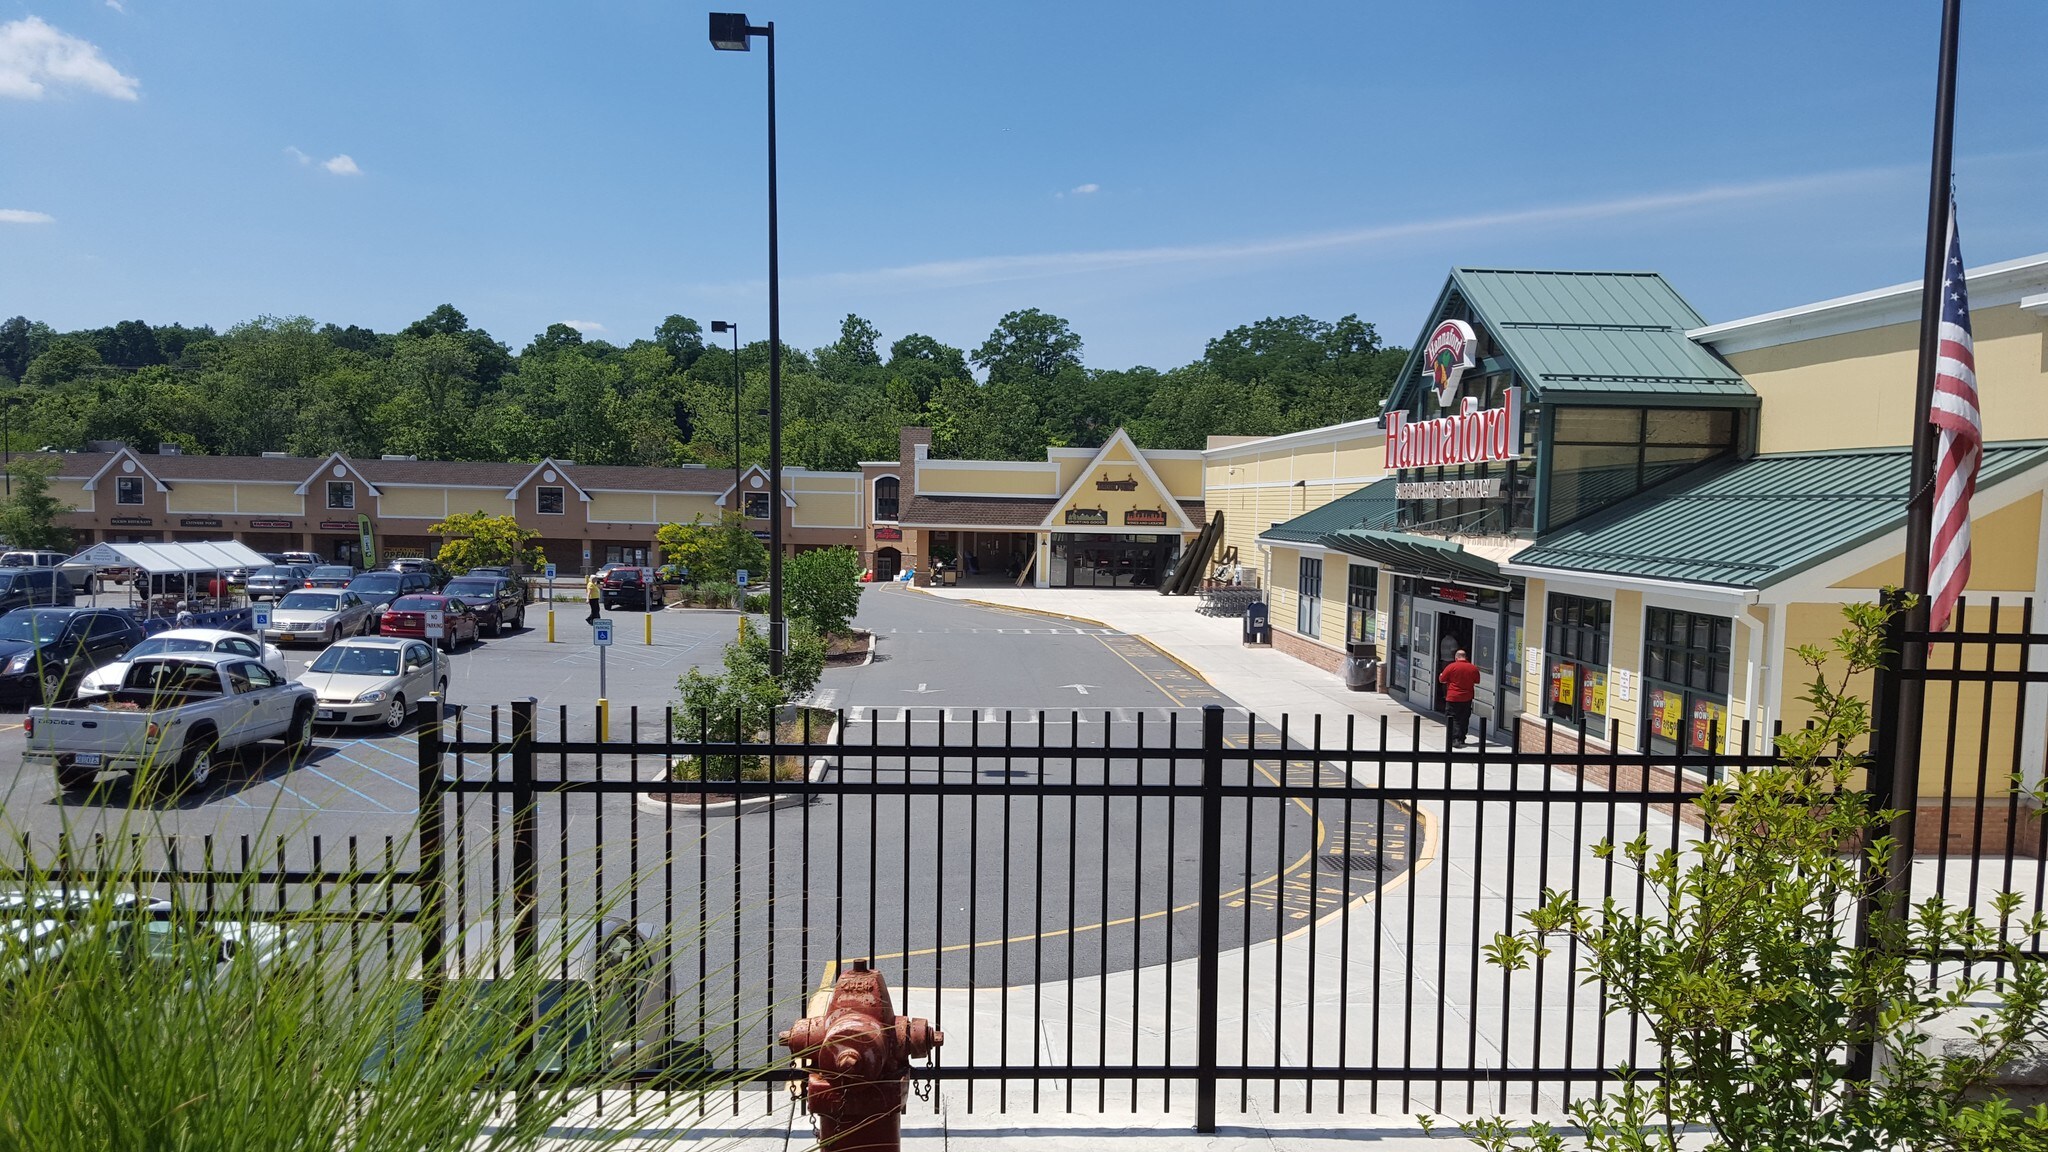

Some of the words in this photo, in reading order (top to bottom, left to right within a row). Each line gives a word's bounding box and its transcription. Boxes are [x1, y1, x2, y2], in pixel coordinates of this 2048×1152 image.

[1428, 327, 1463, 359] Hannaford
[1384, 388, 1512, 470] Hannaford
[1394, 482, 1440, 499] SUPERMARKET
[1451, 479, 1492, 498] PHARMACY
[383, 551, 424, 559] OPENING
[38, 718, 76, 726] DODGE
